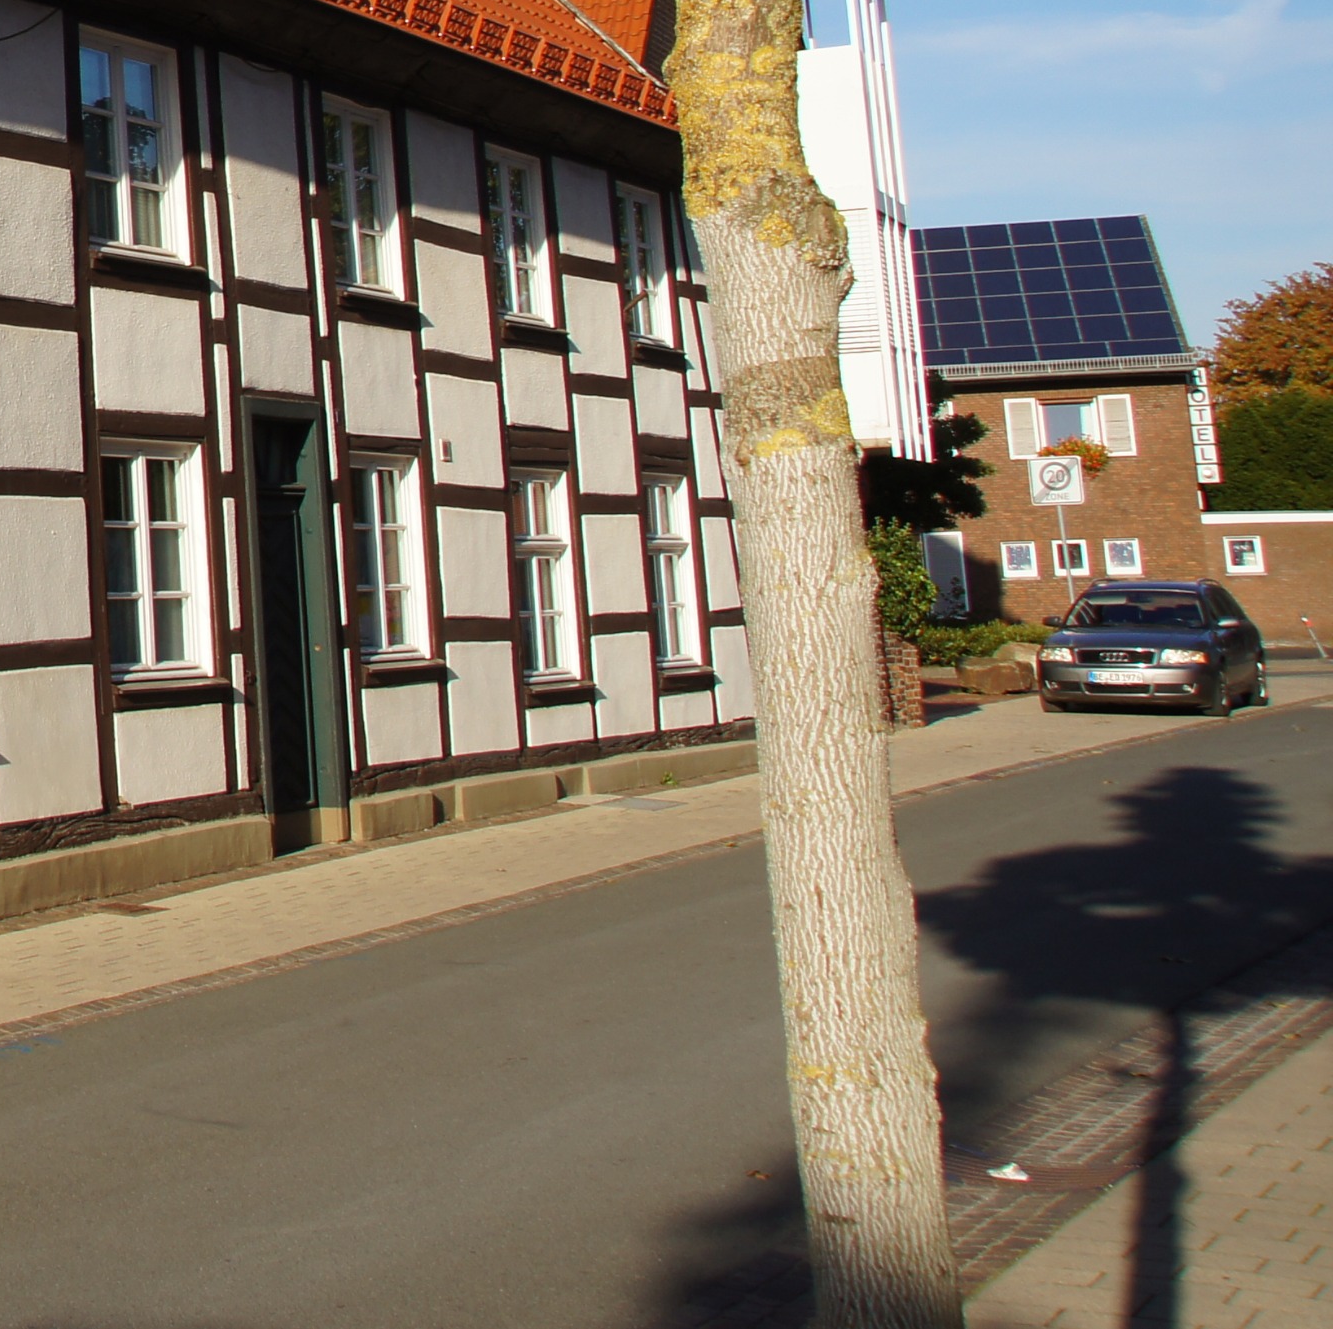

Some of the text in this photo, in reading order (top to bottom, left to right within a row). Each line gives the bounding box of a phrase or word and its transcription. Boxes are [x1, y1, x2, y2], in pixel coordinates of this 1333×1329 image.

[1190, 369, 1213, 461] HOTEL
[1046, 469, 1065, 484] 20
[1045, 492, 1070, 501] ZONE
